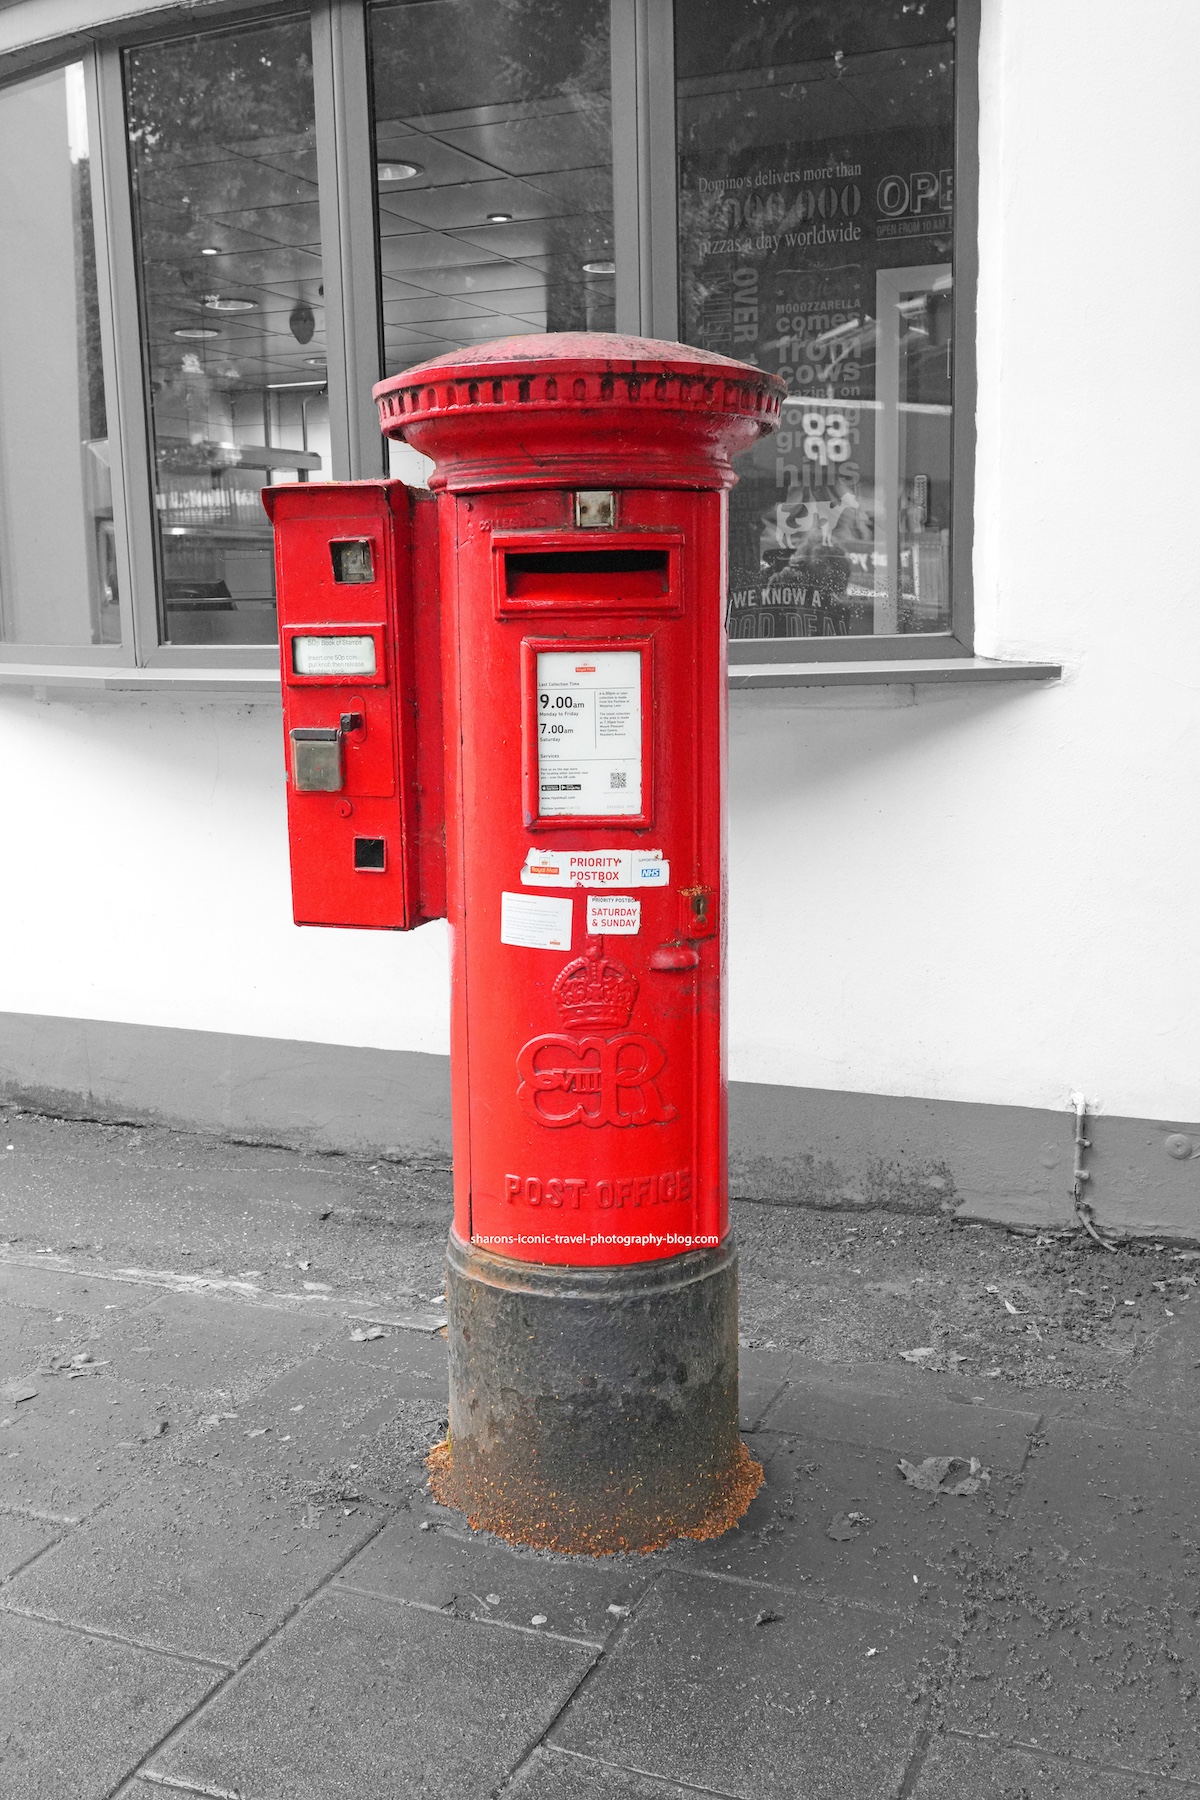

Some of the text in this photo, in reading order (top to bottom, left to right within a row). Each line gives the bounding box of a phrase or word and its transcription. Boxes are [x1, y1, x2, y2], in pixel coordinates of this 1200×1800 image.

[698, 161, 862, 194] Domino's delivers more than
[876, 223, 897, 237] OPEN
[898, 221, 921, 236] FROM
[698, 238, 742, 261] pizzas
[755, 231, 782, 254] day
[784, 222, 862, 247] worldwide
[733, 267, 759, 344] OVER
[775, 299, 862, 315] MOOOZZARELLA
[775, 311, 862, 333] comes
[776, 334, 862, 364] from
[776, 360, 862, 385] cows
[840, 385, 861, 397] on
[775, 456, 861, 488] hills
[732, 586, 822, 608] WE KNOW A
[540, 693, 585, 709] 9.00am
[540, 723, 574, 734] 7.00am
[569, 857, 620, 867] PRIORITY
[569, 870, 620, 881] POSTBOX
[641, 869, 661, 878] NHS
[591, 907, 638, 917] SATURDAY
[591, 918, 637, 928] & SUNDAY
[504, 1167, 693, 1210] POST OFFICE
